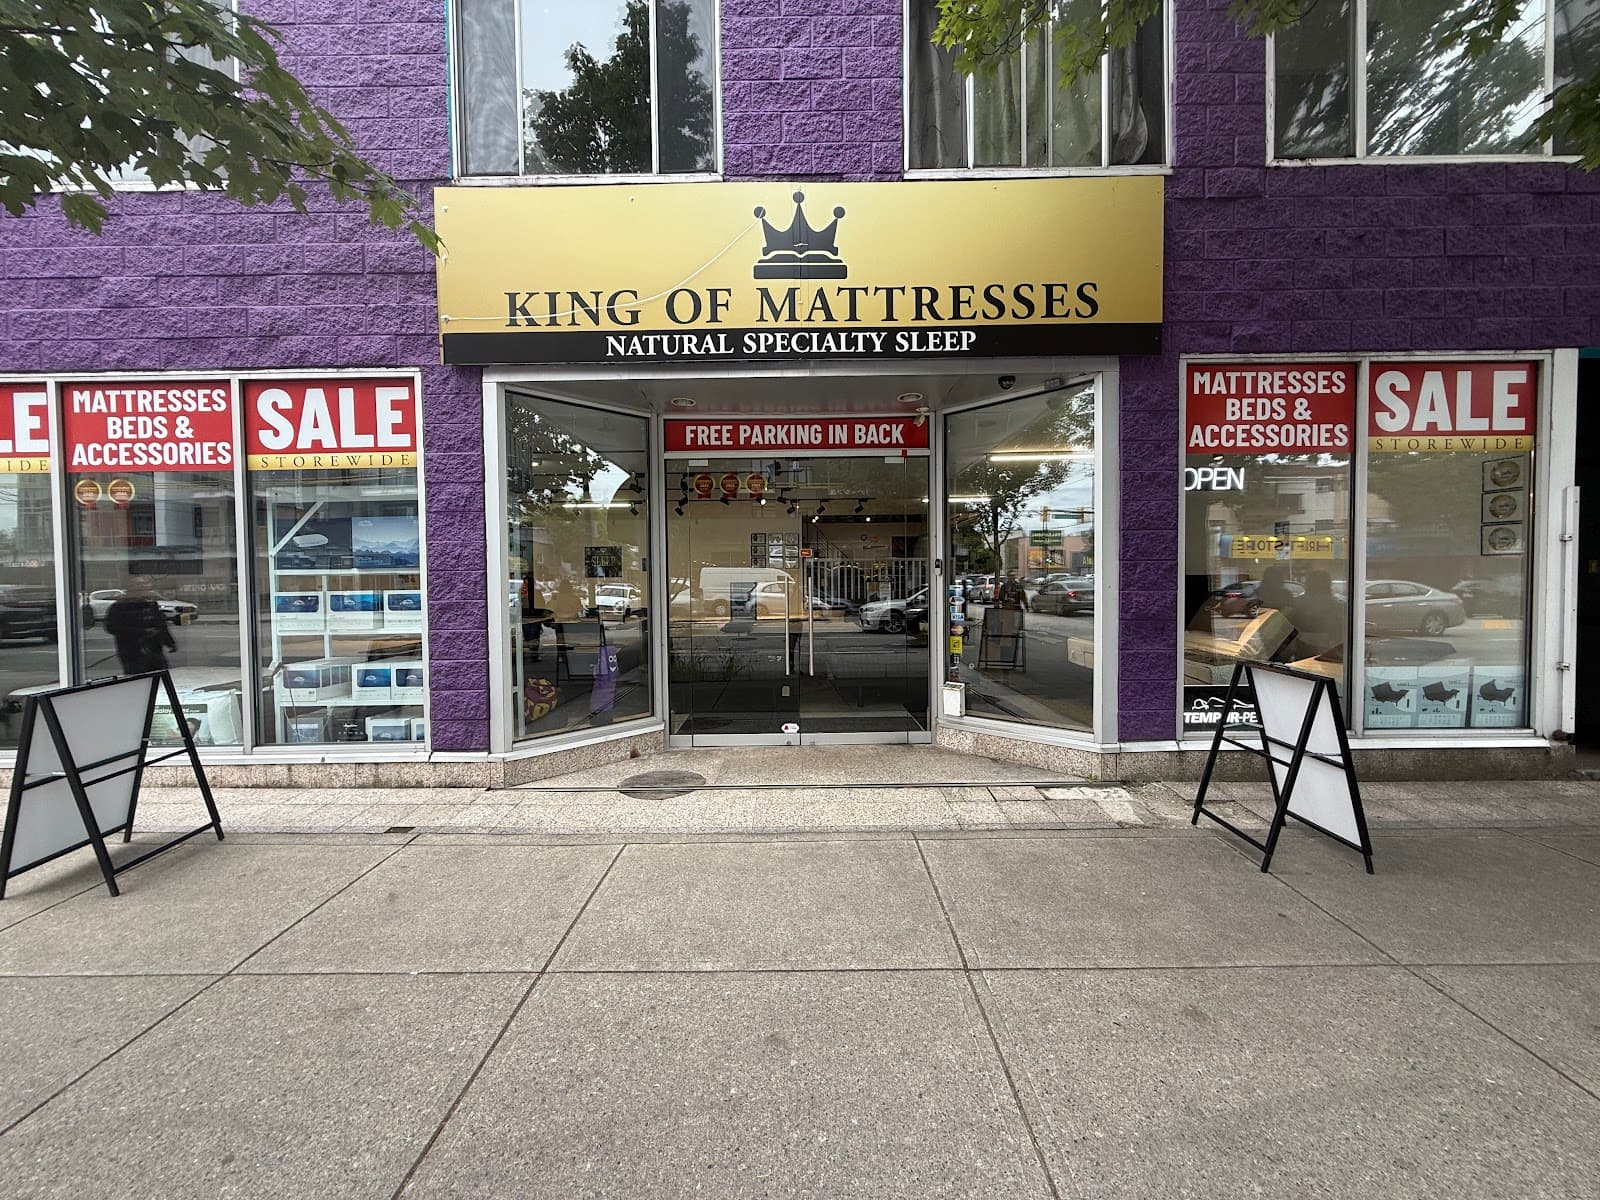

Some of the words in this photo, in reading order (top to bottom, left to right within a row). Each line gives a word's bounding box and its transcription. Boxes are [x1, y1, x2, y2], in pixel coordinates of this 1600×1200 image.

[504, 290, 641, 326] KING
[666, 288, 731, 325] OF
[755, 282, 1099, 324] MATTRESSES
[606, 332, 734, 357] NATURAL
[742, 331, 886, 354] SPECIALTY
[895, 330, 977, 353] SLEEP
[1193, 371, 1346, 395] MATTRESSES
[73, 389, 226, 414] MATTRESSES
[1225, 397, 1286, 421] BEDS
[1293, 397, 1312, 421] &
[1375, 370, 1527, 432] SALE
[107, 415, 168, 440] BEDS
[174, 415, 195, 439] &
[257, 386, 411, 450] SALE
[686, 425, 733, 446] FREE
[739, 424, 823, 446] PARKING
[828, 424, 848, 445] IN
[854, 423, 905, 445] BACK
[1189, 423, 1348, 448] ACCESSORIES
[1376, 438, 1524, 450] STOREWIDE
[72, 441, 232, 466] ACCESSORIES
[260, 454, 411, 469] STOREWIDE
[1184, 467, 1245, 491] OPEN
